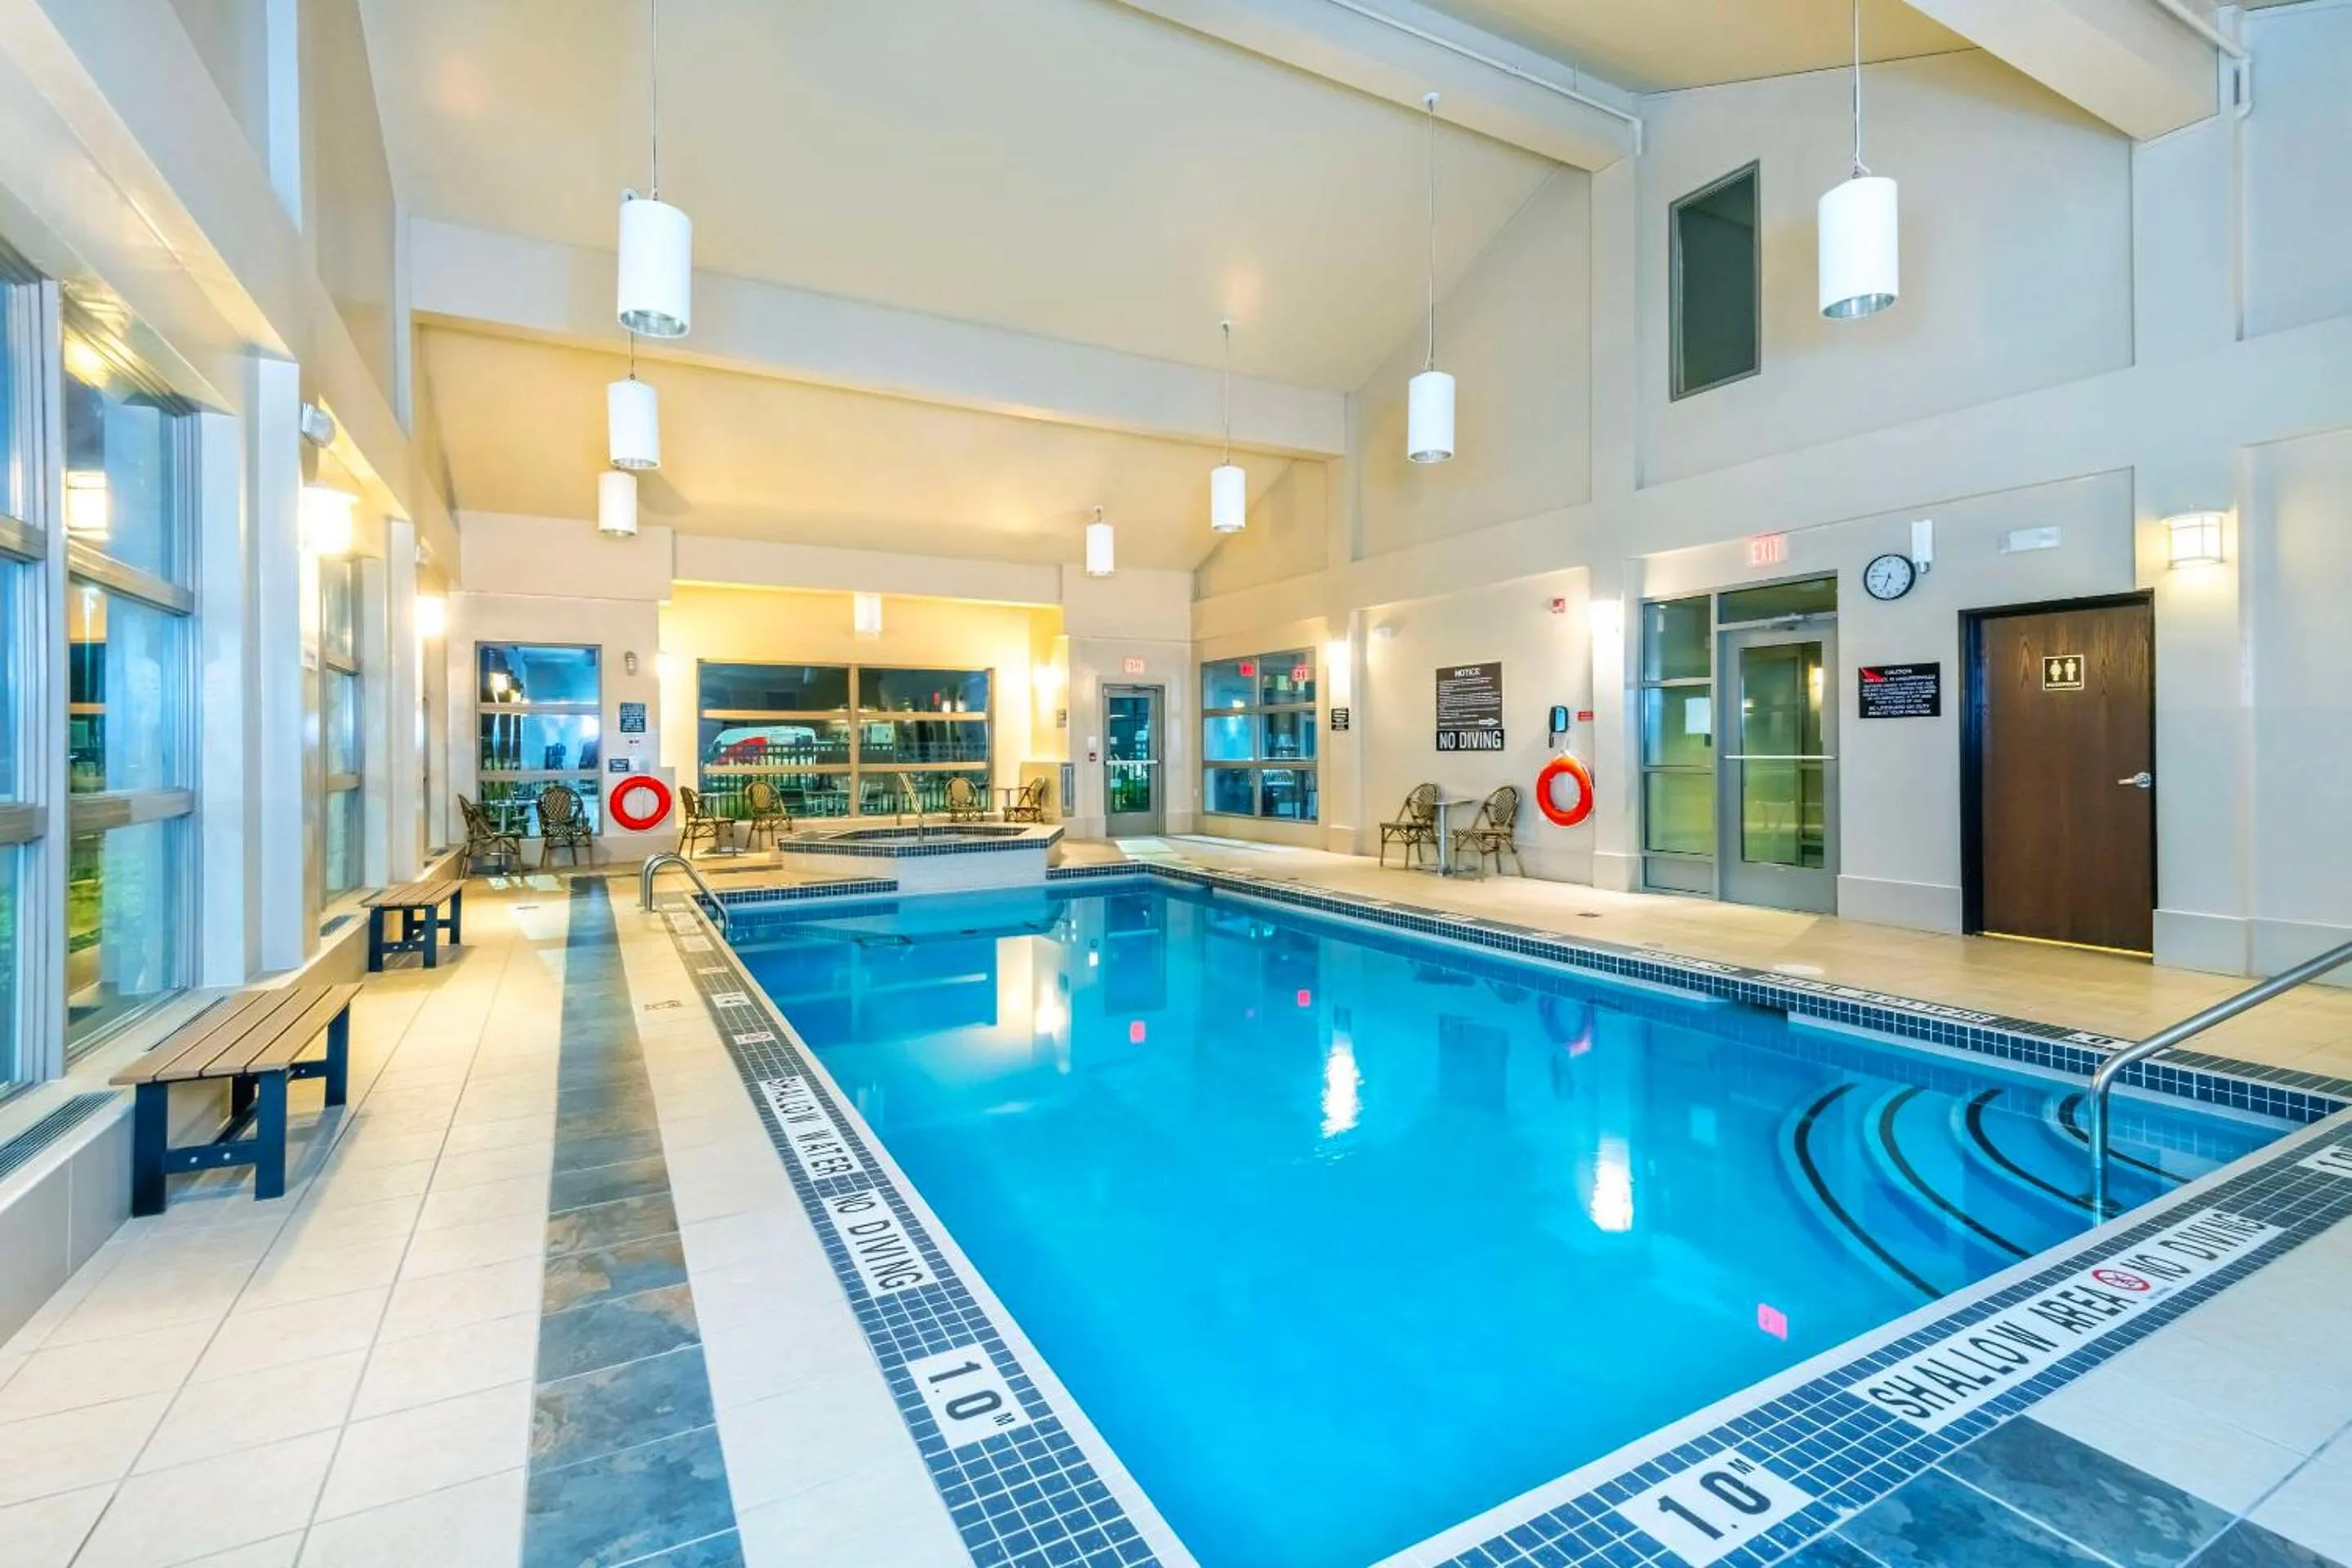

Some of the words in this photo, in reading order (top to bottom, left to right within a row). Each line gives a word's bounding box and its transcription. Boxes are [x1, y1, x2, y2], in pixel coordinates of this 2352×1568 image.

[1751, 537, 1782, 564] EXIT
[1454, 667, 1481, 677] NOTICE
[1439, 732, 1455, 749] NO
[1459, 730, 1501, 749] DIVING
[767, 1077, 822, 1124] SHALLOW
[795, 1129, 854, 1177] WATER
[830, 1192, 876, 1214] NO
[847, 1219, 924, 1290] DIVING
[1868, 1320, 2059, 1419] SHALLOW
[2027, 1285, 2138, 1334] AREA
[2120, 1254, 2192, 1282] NO
[2158, 1210, 2268, 1263] DIVING
